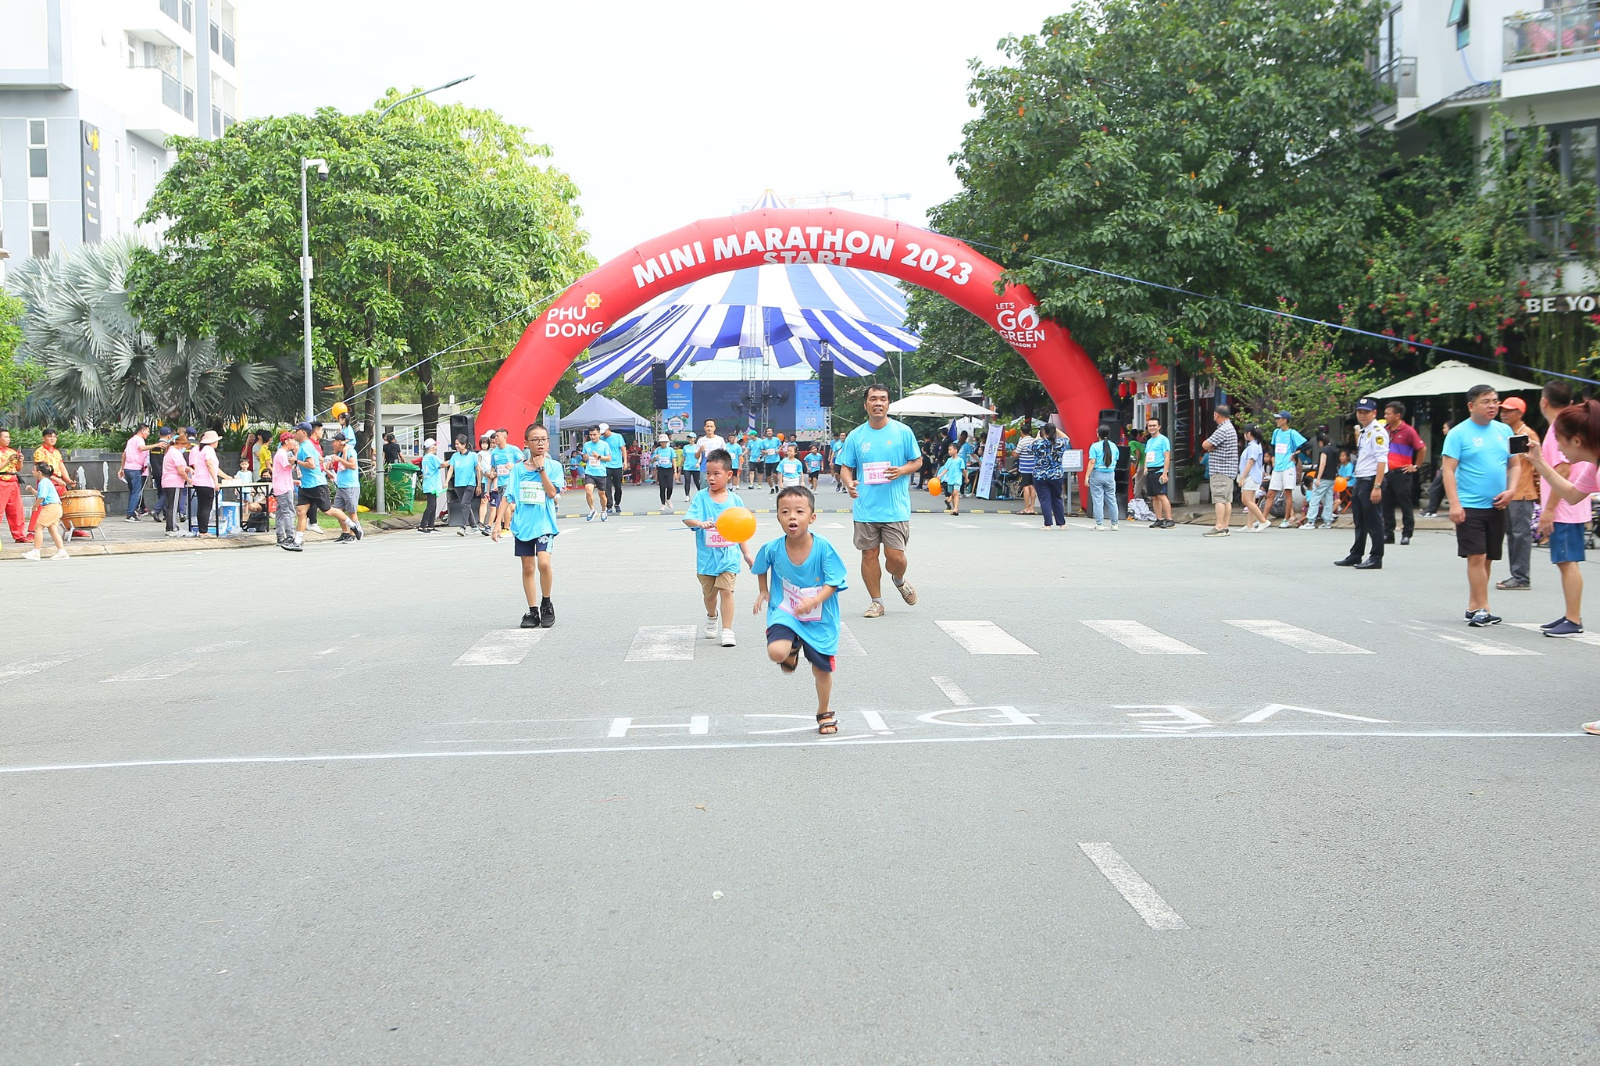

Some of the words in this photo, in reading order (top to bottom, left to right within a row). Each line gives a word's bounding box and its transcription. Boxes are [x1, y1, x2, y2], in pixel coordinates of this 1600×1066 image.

[632, 241, 706, 288] MINI
[713, 226, 895, 261] MARATHON
[901, 243, 973, 285] 2023
[763, 251, 852, 267] START
[995, 302, 1015, 310] LET'S
[1525, 298, 1557, 313] BE
[1565, 295, 1600, 312] YO
[547, 306, 587, 321] PHU
[997, 308, 1040, 331] GO
[545, 321, 604, 337] DONG
[999, 329, 1046, 342] GREEN
